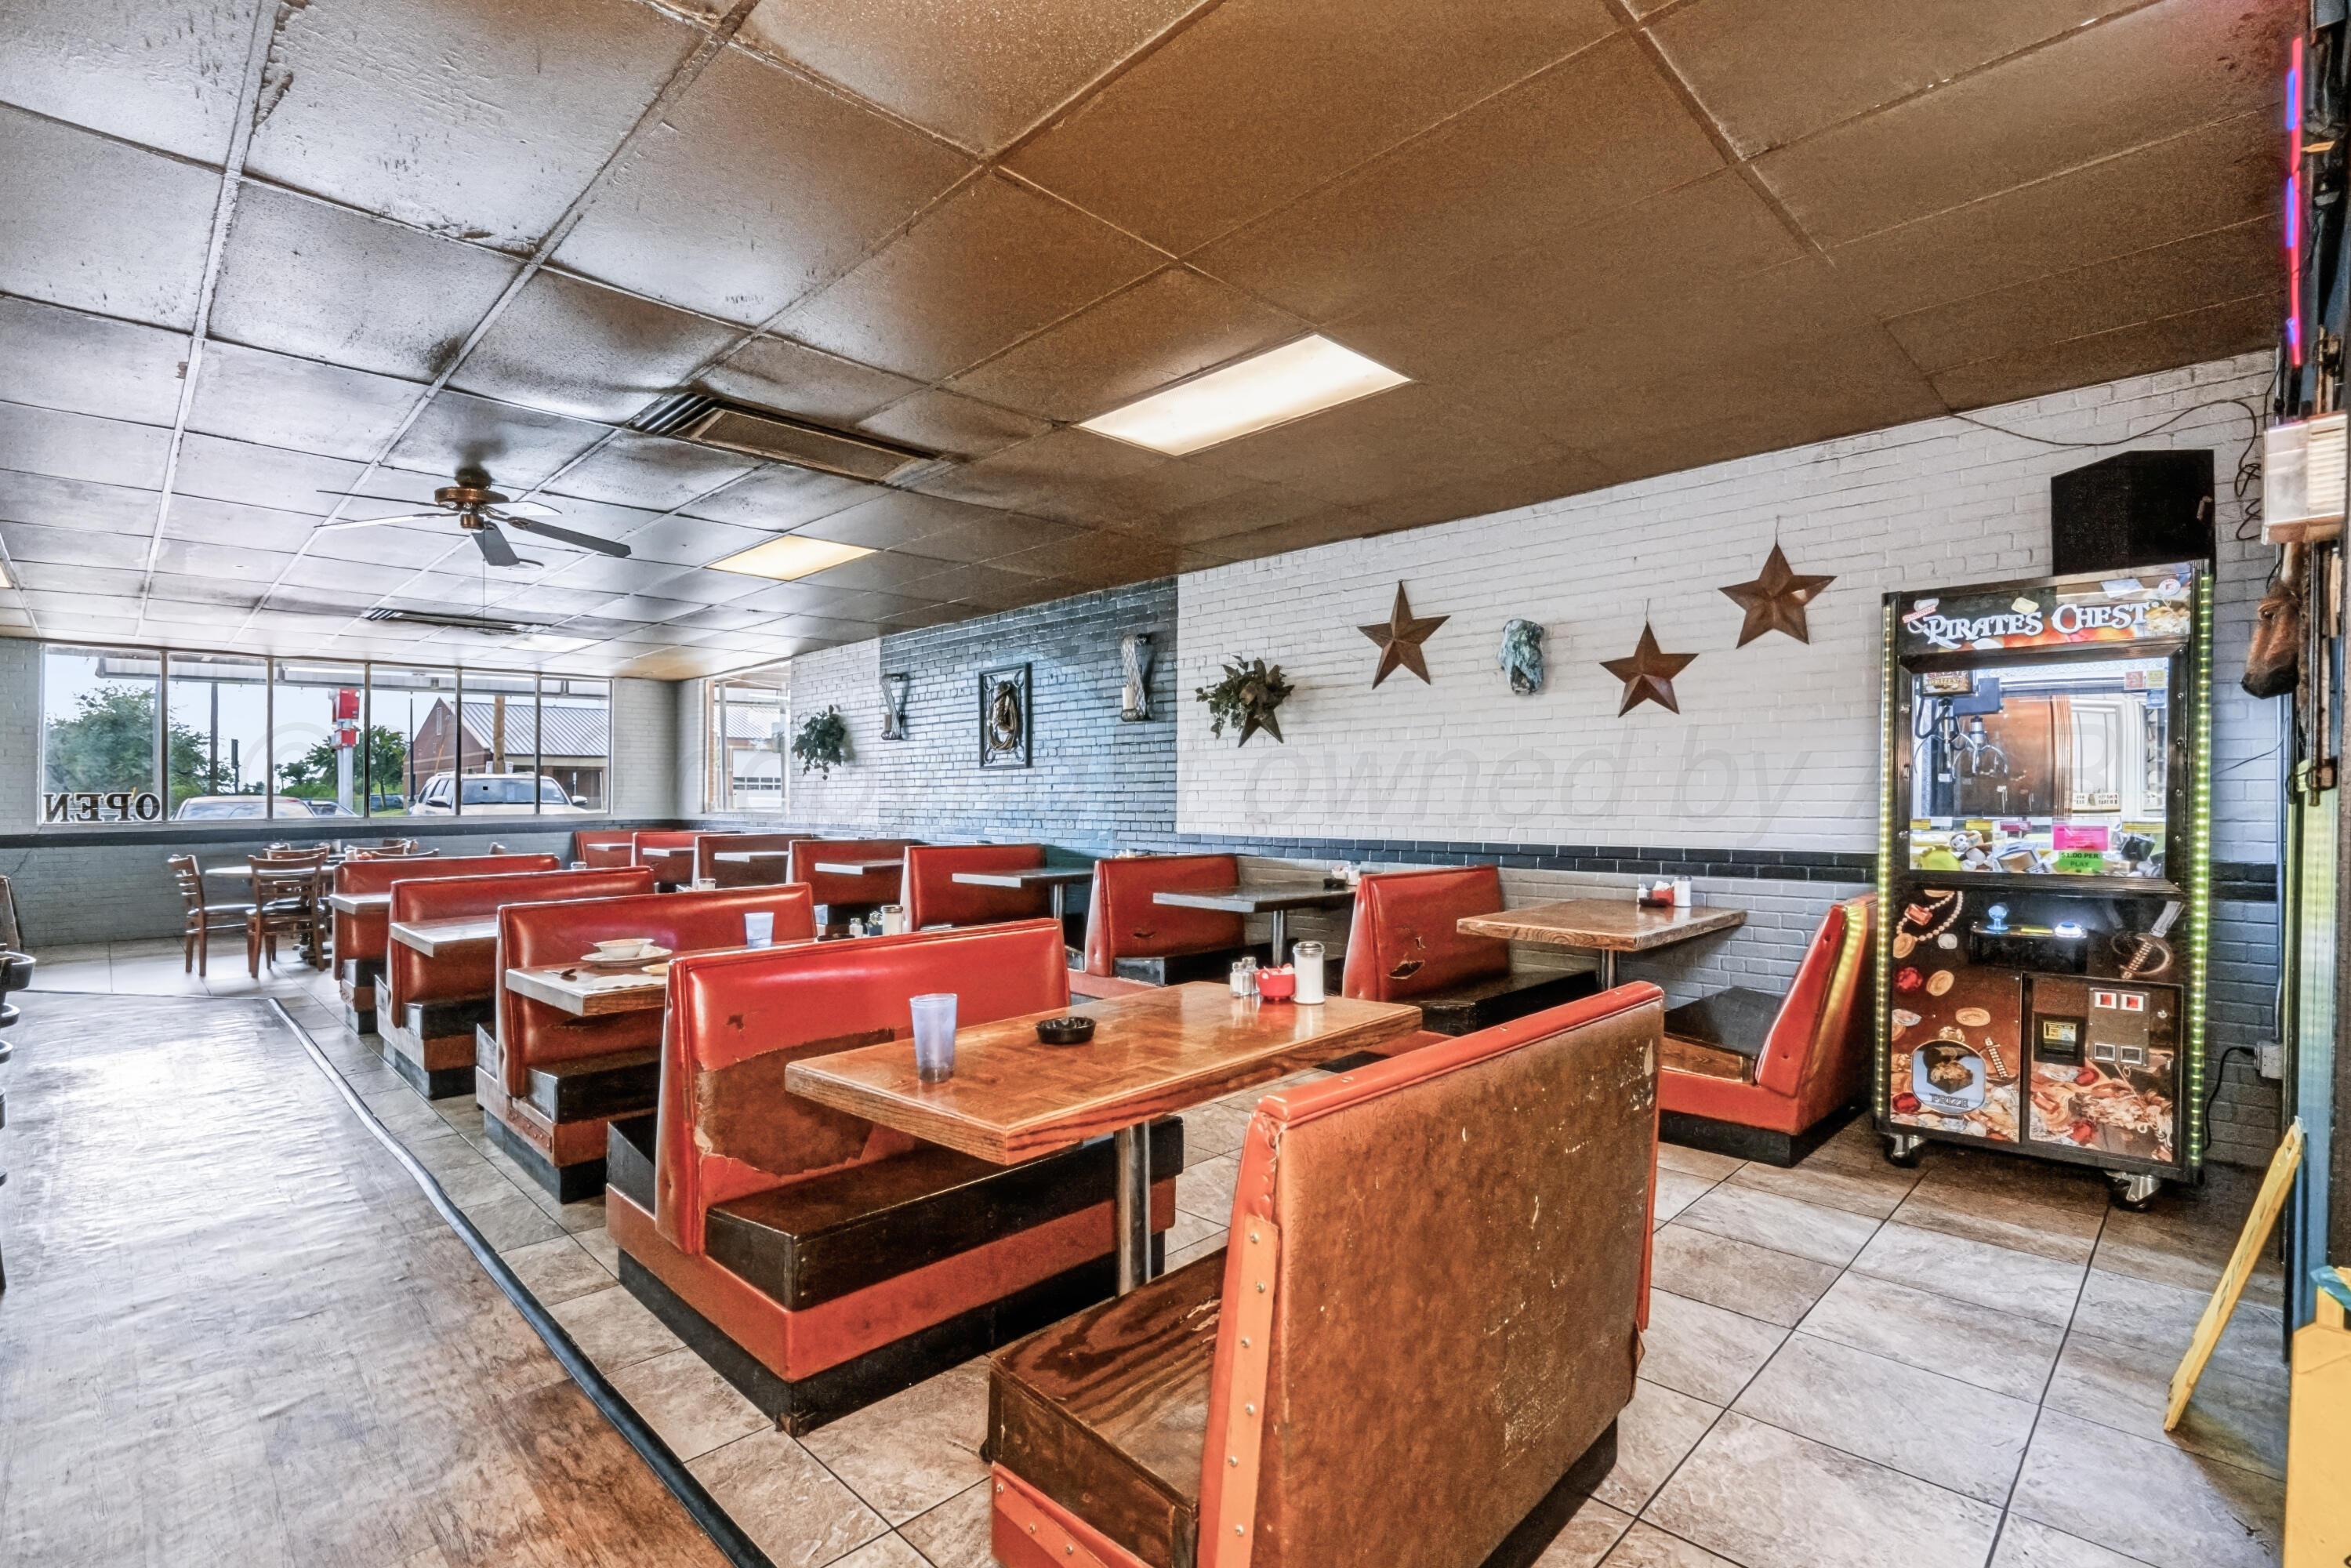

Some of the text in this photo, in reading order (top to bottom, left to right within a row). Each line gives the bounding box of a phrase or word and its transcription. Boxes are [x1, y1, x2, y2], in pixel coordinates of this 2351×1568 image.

[1908, 611, 2044, 650] PIRATES
[2051, 603, 2150, 634] CHEST
[1929, 1093, 1969, 1109] PRIZE
